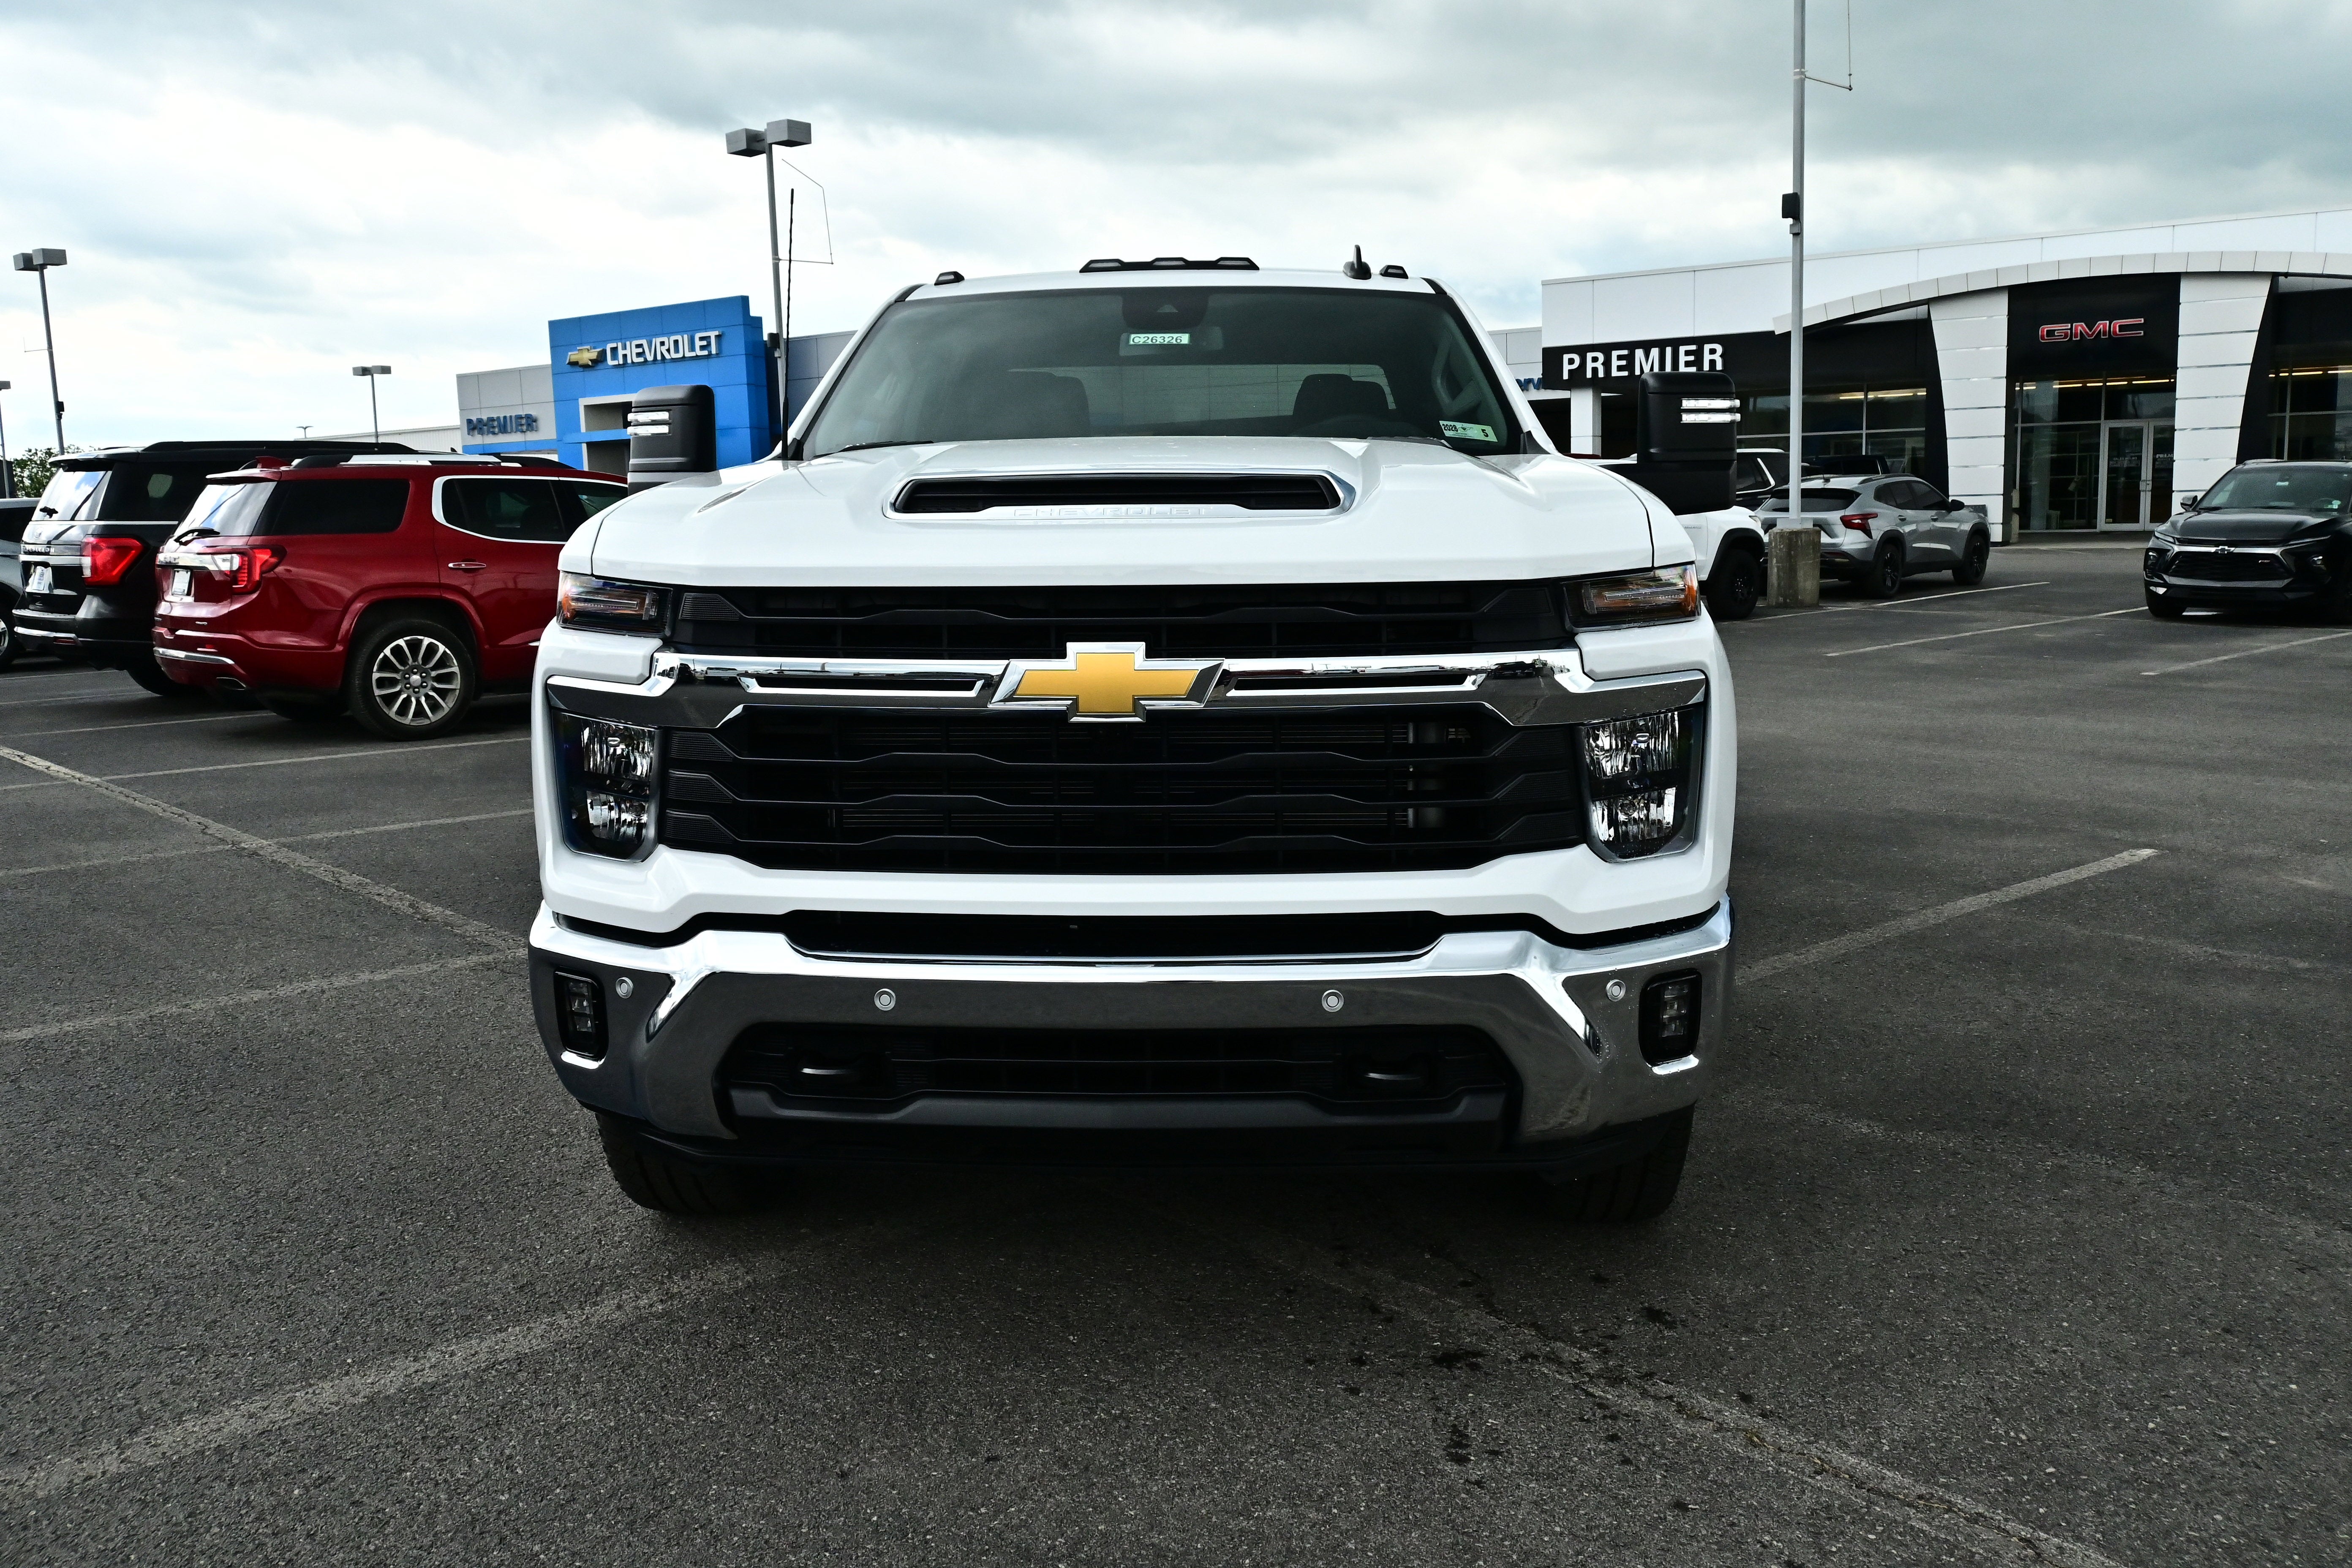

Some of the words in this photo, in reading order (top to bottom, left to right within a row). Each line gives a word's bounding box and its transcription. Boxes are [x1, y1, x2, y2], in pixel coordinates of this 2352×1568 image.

[2039, 318, 2144, 343] GMC
[606, 331, 721, 365] CHEVROLET
[1563, 343, 1723, 380] PREMIER
[466, 414, 538, 436] PREMIER
[1442, 424, 1458, 432] 2028
[1481, 428, 1489, 437] 5
[1014, 507, 1211, 516] CHEVROLET
